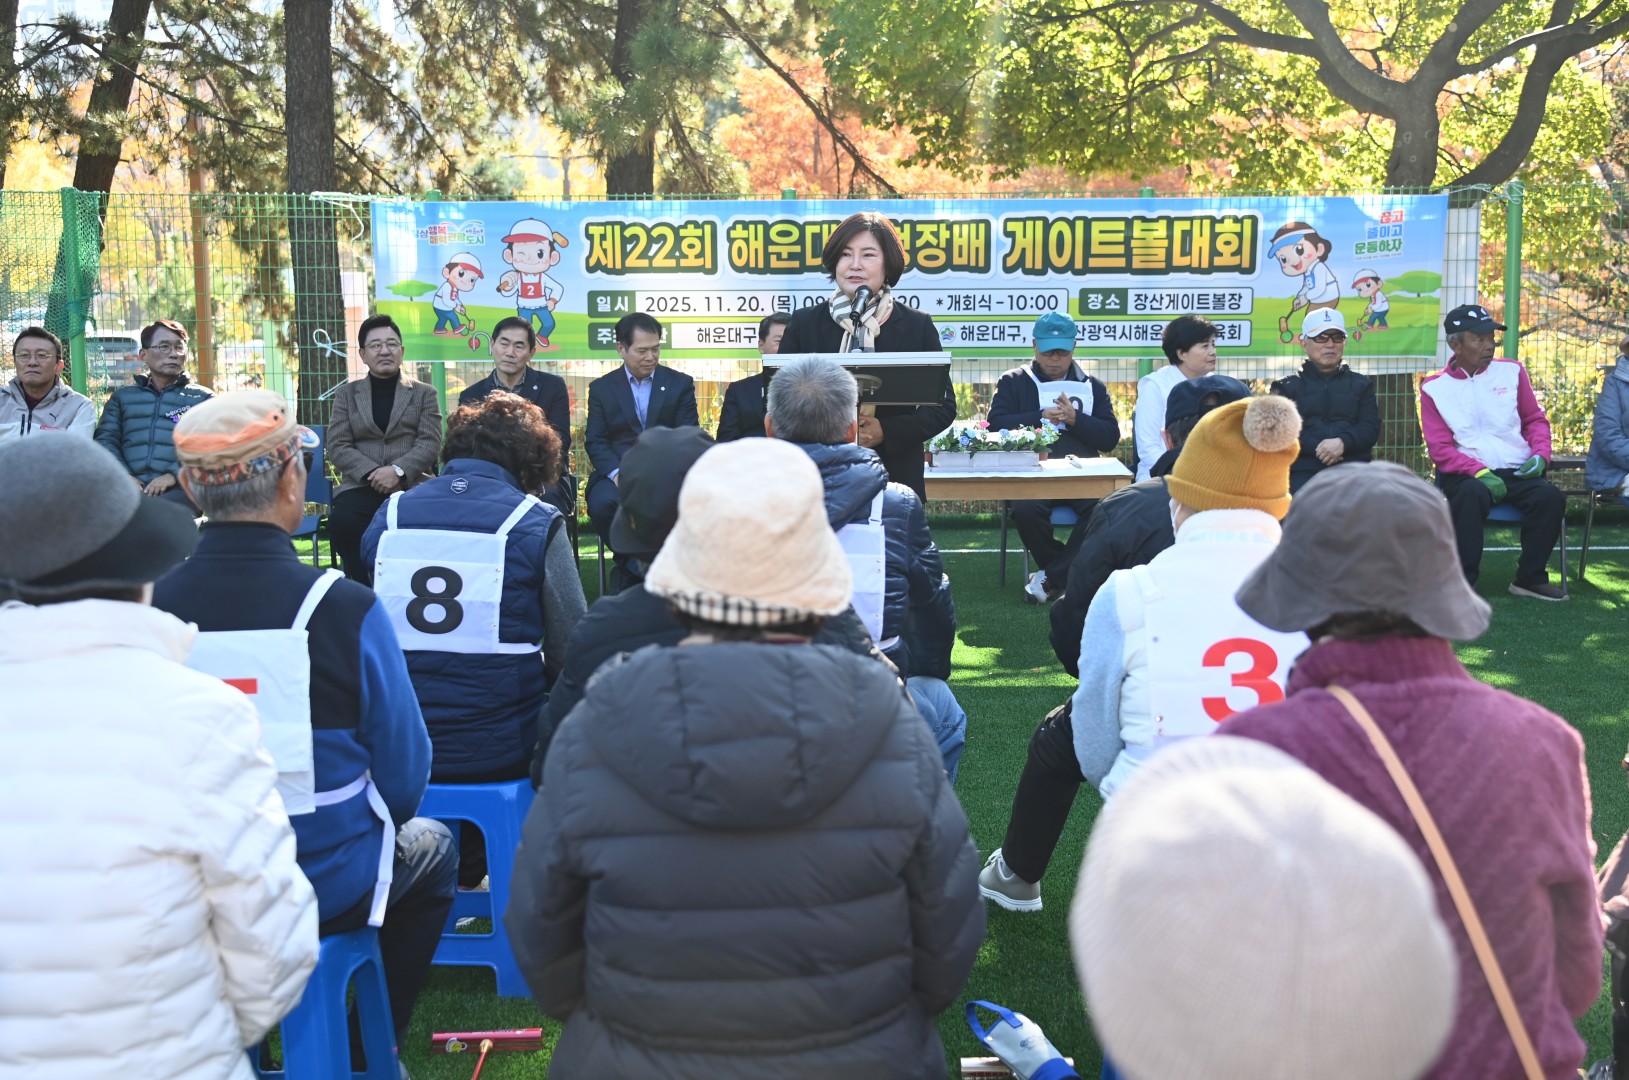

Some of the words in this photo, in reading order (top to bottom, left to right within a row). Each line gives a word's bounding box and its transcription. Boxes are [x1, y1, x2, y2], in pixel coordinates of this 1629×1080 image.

[588, 224, 712, 269] 제22회
[1006, 218, 1252, 270] 게이트볼대회
[1354, 239, 1403, 255] 운동하자
[527, 285, 535, 296] 2
[645, 297, 697, 312] 2025.
[704, 297, 731, 312] 11.
[737, 296, 764, 312] 20.
[771, 295, 797, 313] (목)
[1133, 293, 1243, 312] 장산게이트볼장
[961, 325, 1027, 343] 해운대구,
[406, 566, 463, 634] 8
[1202, 637, 1285, 723] 3
